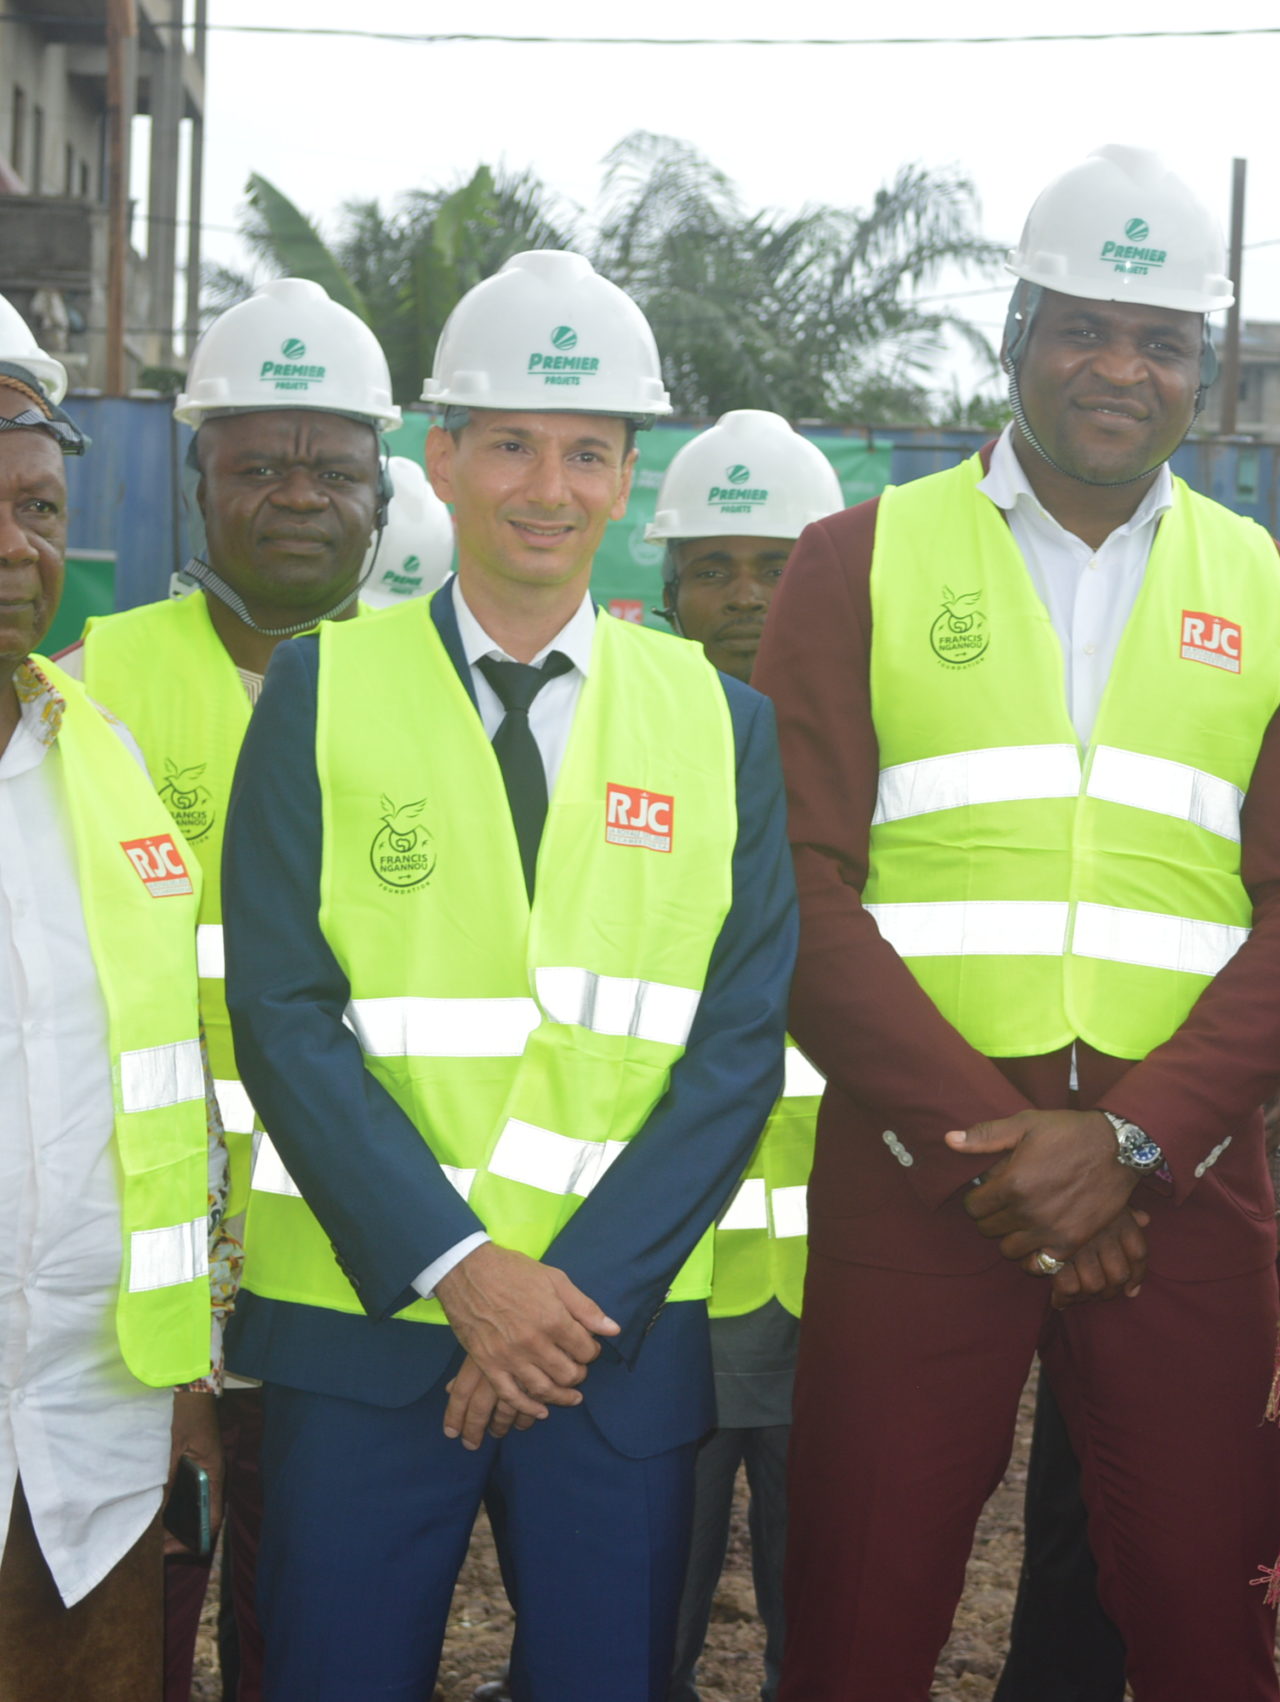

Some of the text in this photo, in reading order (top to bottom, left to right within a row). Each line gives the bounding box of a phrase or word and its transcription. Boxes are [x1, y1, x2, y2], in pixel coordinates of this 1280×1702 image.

[1101, 241, 1167, 263] PREMIER
[260, 361, 326, 378] PREMIER
[528, 352, 599, 370] PREMIER
[708, 487, 768, 502] PREMIER
[939, 634, 983, 643] FRANCIS
[1183, 617, 1239, 657] RJC
[171, 811, 207, 819] ANCIS
[608, 791, 669, 833] RJC
[127, 842, 184, 879] RJC
[380, 854, 428, 864] FRANCIS
[380, 863, 428, 872] NGANNOU
